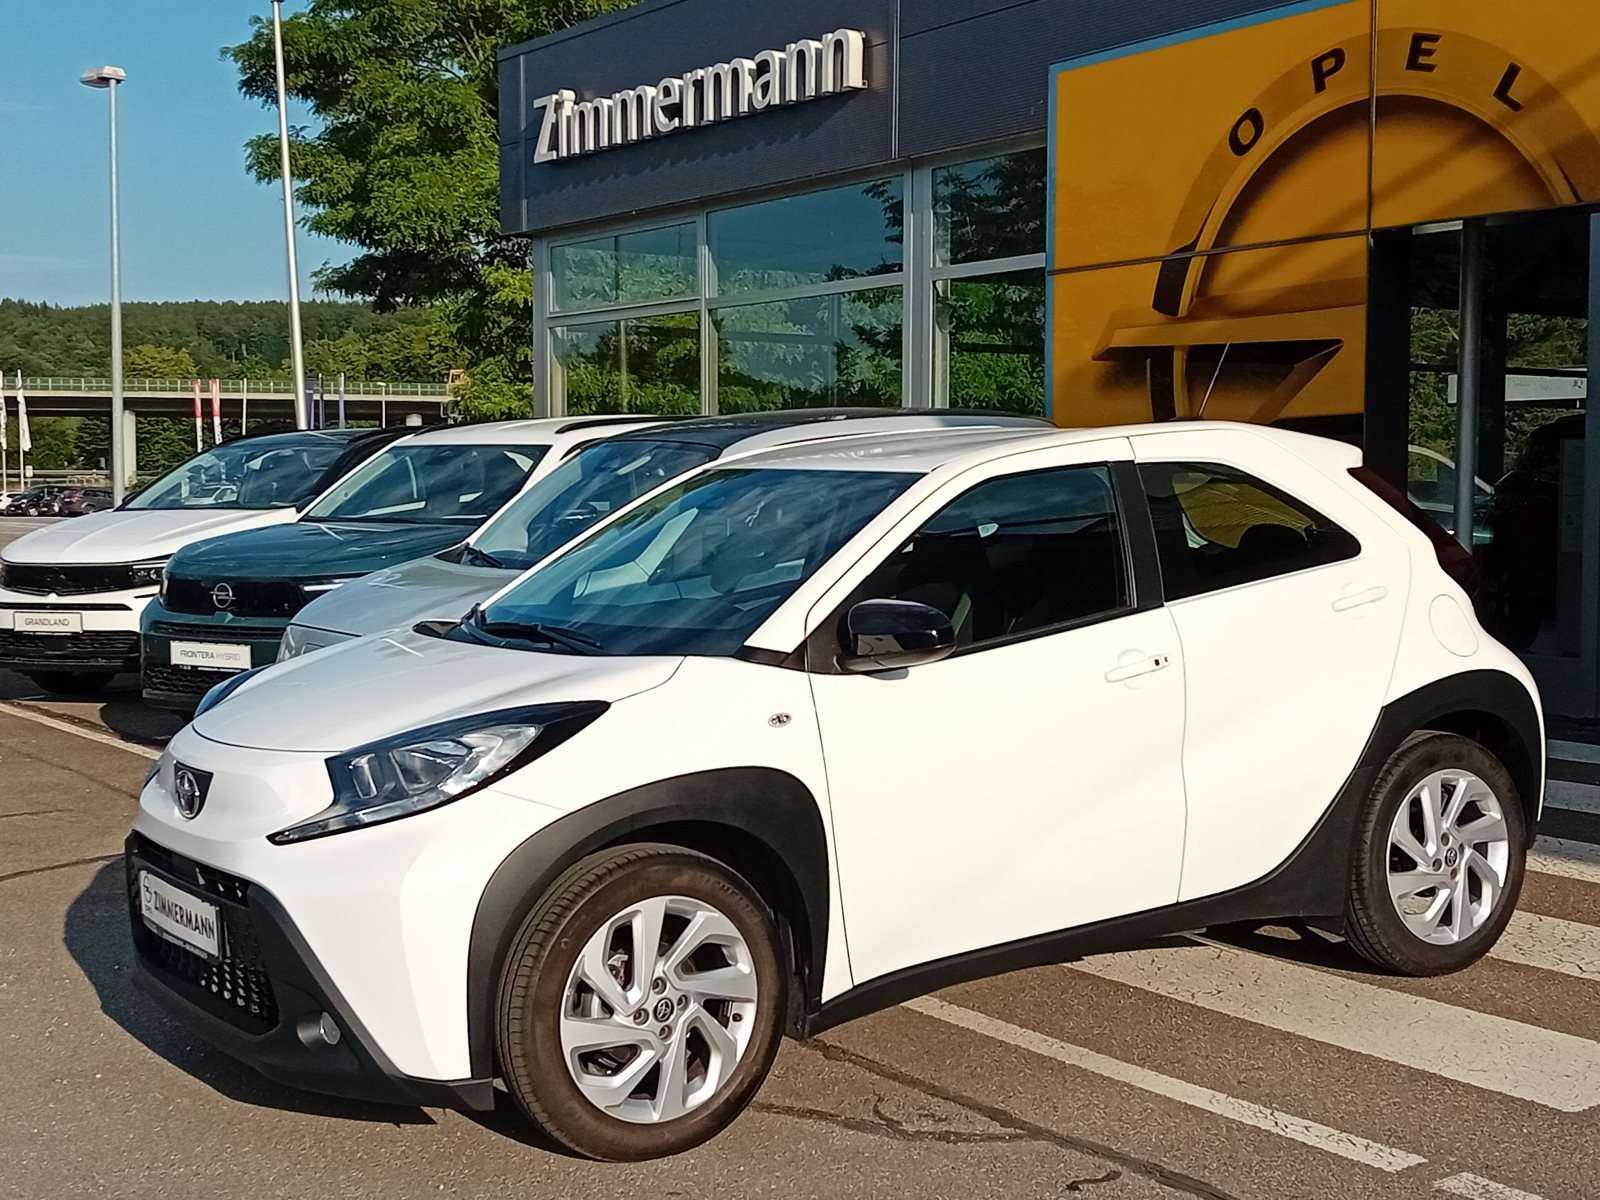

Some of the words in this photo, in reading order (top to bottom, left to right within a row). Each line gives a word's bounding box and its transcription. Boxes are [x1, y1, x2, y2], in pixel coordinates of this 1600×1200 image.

[533, 28, 867, 163] Zimmermann
[1228, 32, 1523, 156] OPEL
[25, 618, 70, 627] GRANDLAND
[180, 649, 214, 659] FRONTERA
[153, 890, 215, 940] ZIMMERMANN
